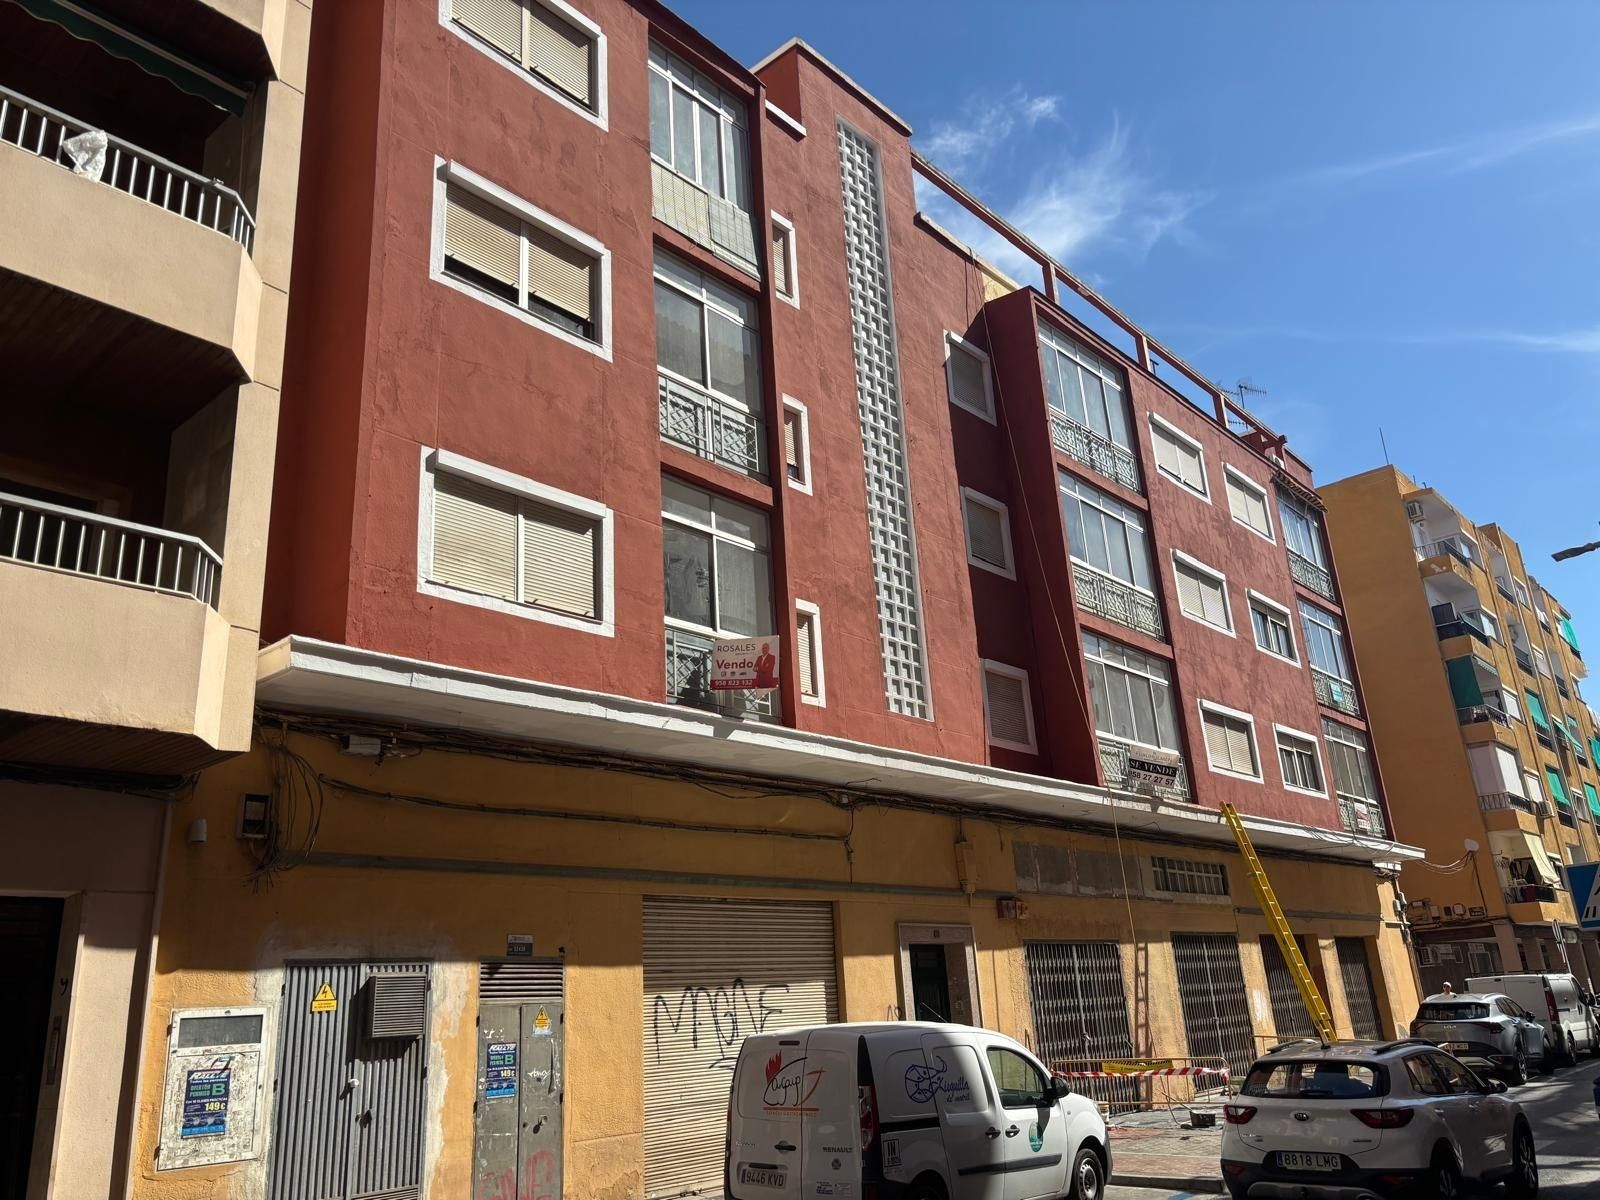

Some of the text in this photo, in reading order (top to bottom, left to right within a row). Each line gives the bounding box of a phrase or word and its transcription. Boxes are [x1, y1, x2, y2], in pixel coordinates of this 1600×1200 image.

[717, 643, 756, 653] ROSALES
[716, 658, 753, 670] Vendo
[1130, 760, 1176, 776] SE VENDE
[1154, 776, 1163, 784] 27
[505, 1054, 514, 1065] B
[212, 1083, 226, 1096] B
[1284, 1153, 1338, 1168] 8818 LMG
[746, 1171, 766, 1184] 9446
